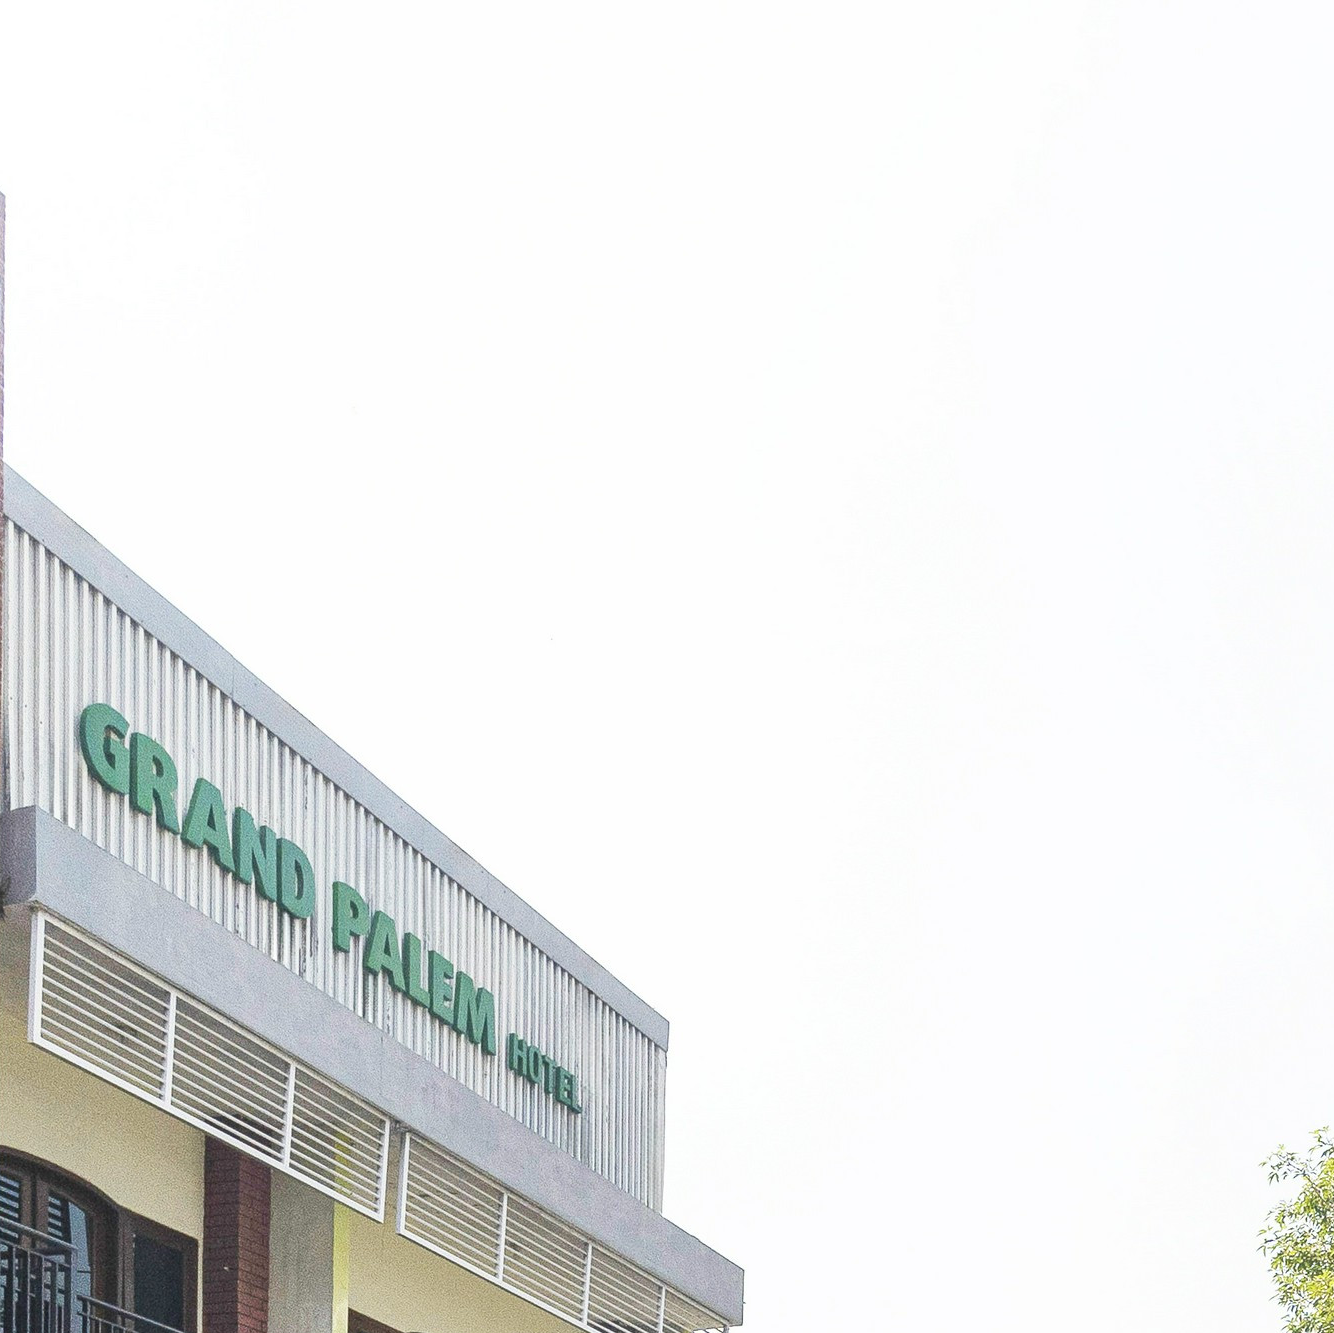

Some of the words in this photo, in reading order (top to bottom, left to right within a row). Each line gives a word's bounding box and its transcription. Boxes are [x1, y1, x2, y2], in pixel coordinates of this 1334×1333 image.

[80, 703, 316, 919] GRAND
[332, 881, 497, 1056] PALEM
[508, 1033, 583, 1114] HOTEL
